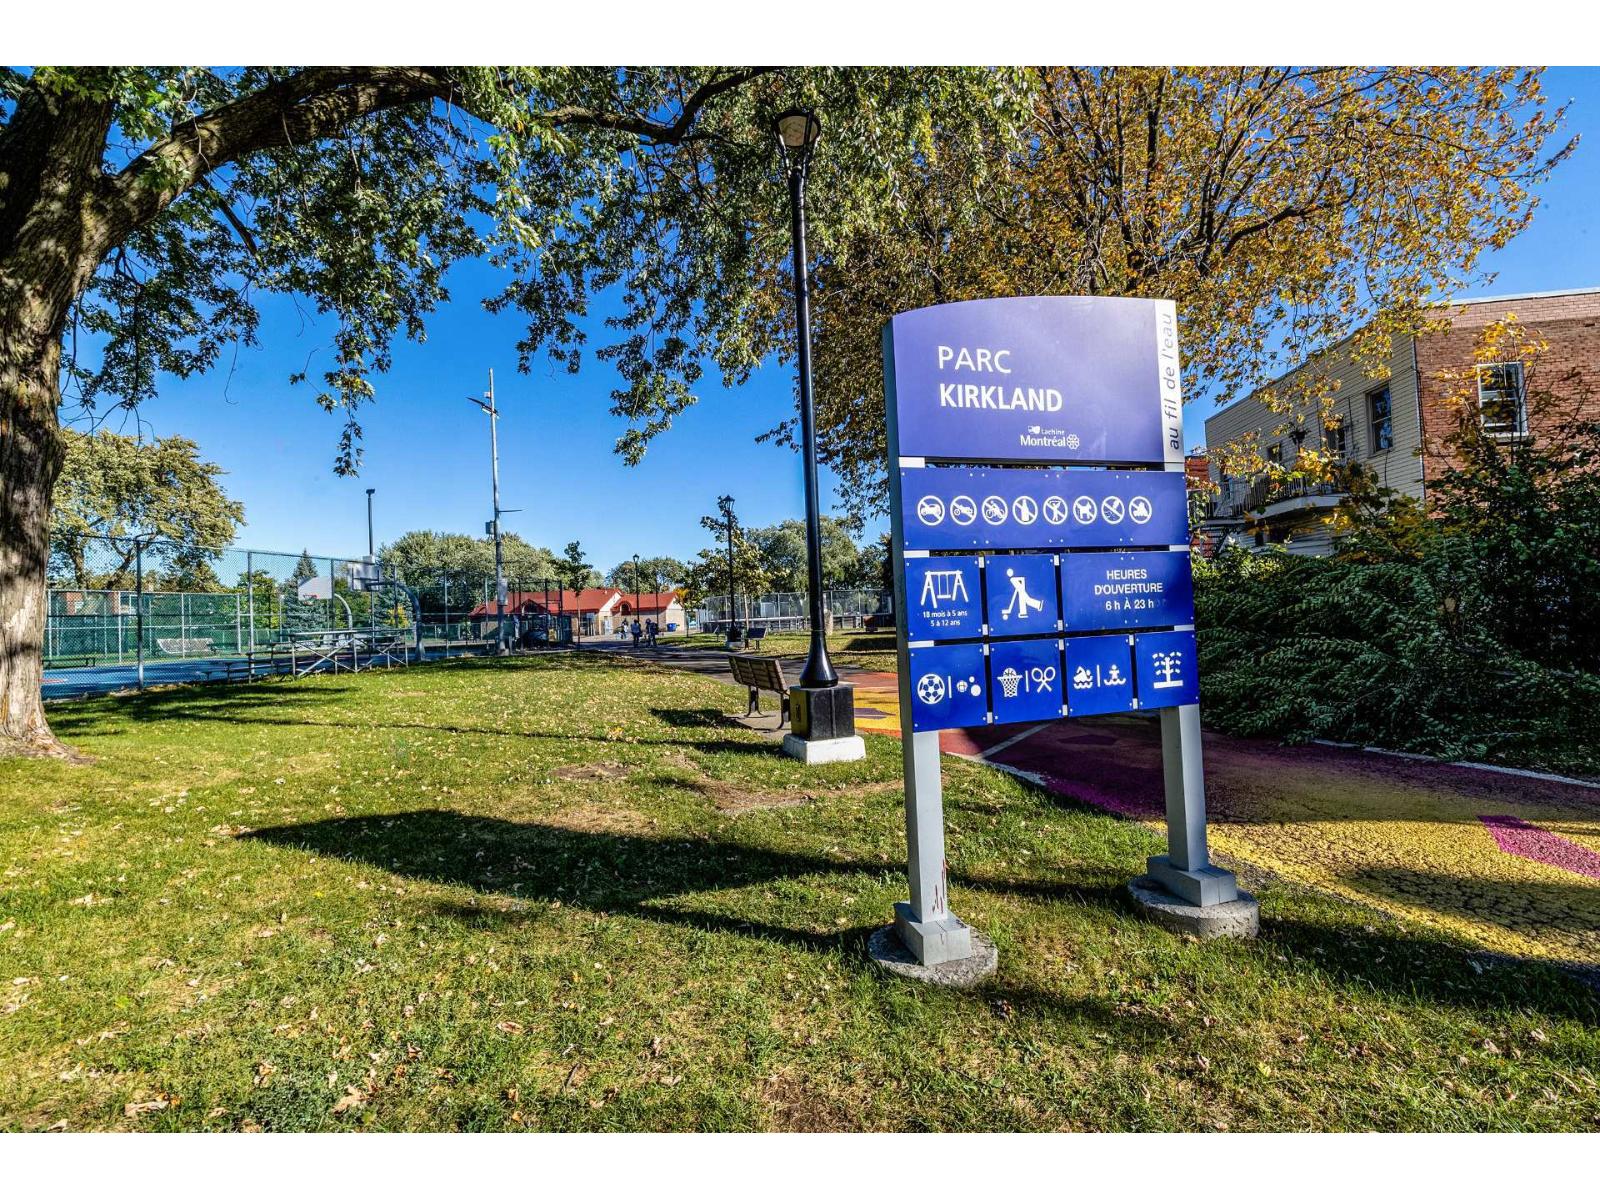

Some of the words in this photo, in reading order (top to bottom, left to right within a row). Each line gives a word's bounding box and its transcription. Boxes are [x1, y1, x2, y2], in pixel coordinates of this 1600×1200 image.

[1161, 313, 1174, 359] l'eau
[938, 345, 1012, 374] PARC
[1163, 366, 1175, 390] de
[939, 383, 1063, 412] KIRKLAND
[1163, 398, 1177, 419] fil
[1020, 435, 1066, 447] Montréal
[1169, 427, 1179, 450] au
[1106, 569, 1147, 580] HEURES
[1094, 582, 1163, 595] D'OUVERTURE
[1106, 600, 1112, 610] 6
[1114, 600, 1120, 610] h
[1123, 597, 1131, 610] À
[1134, 599, 1146, 609] 23
[1148, 598, 1154, 609] h
